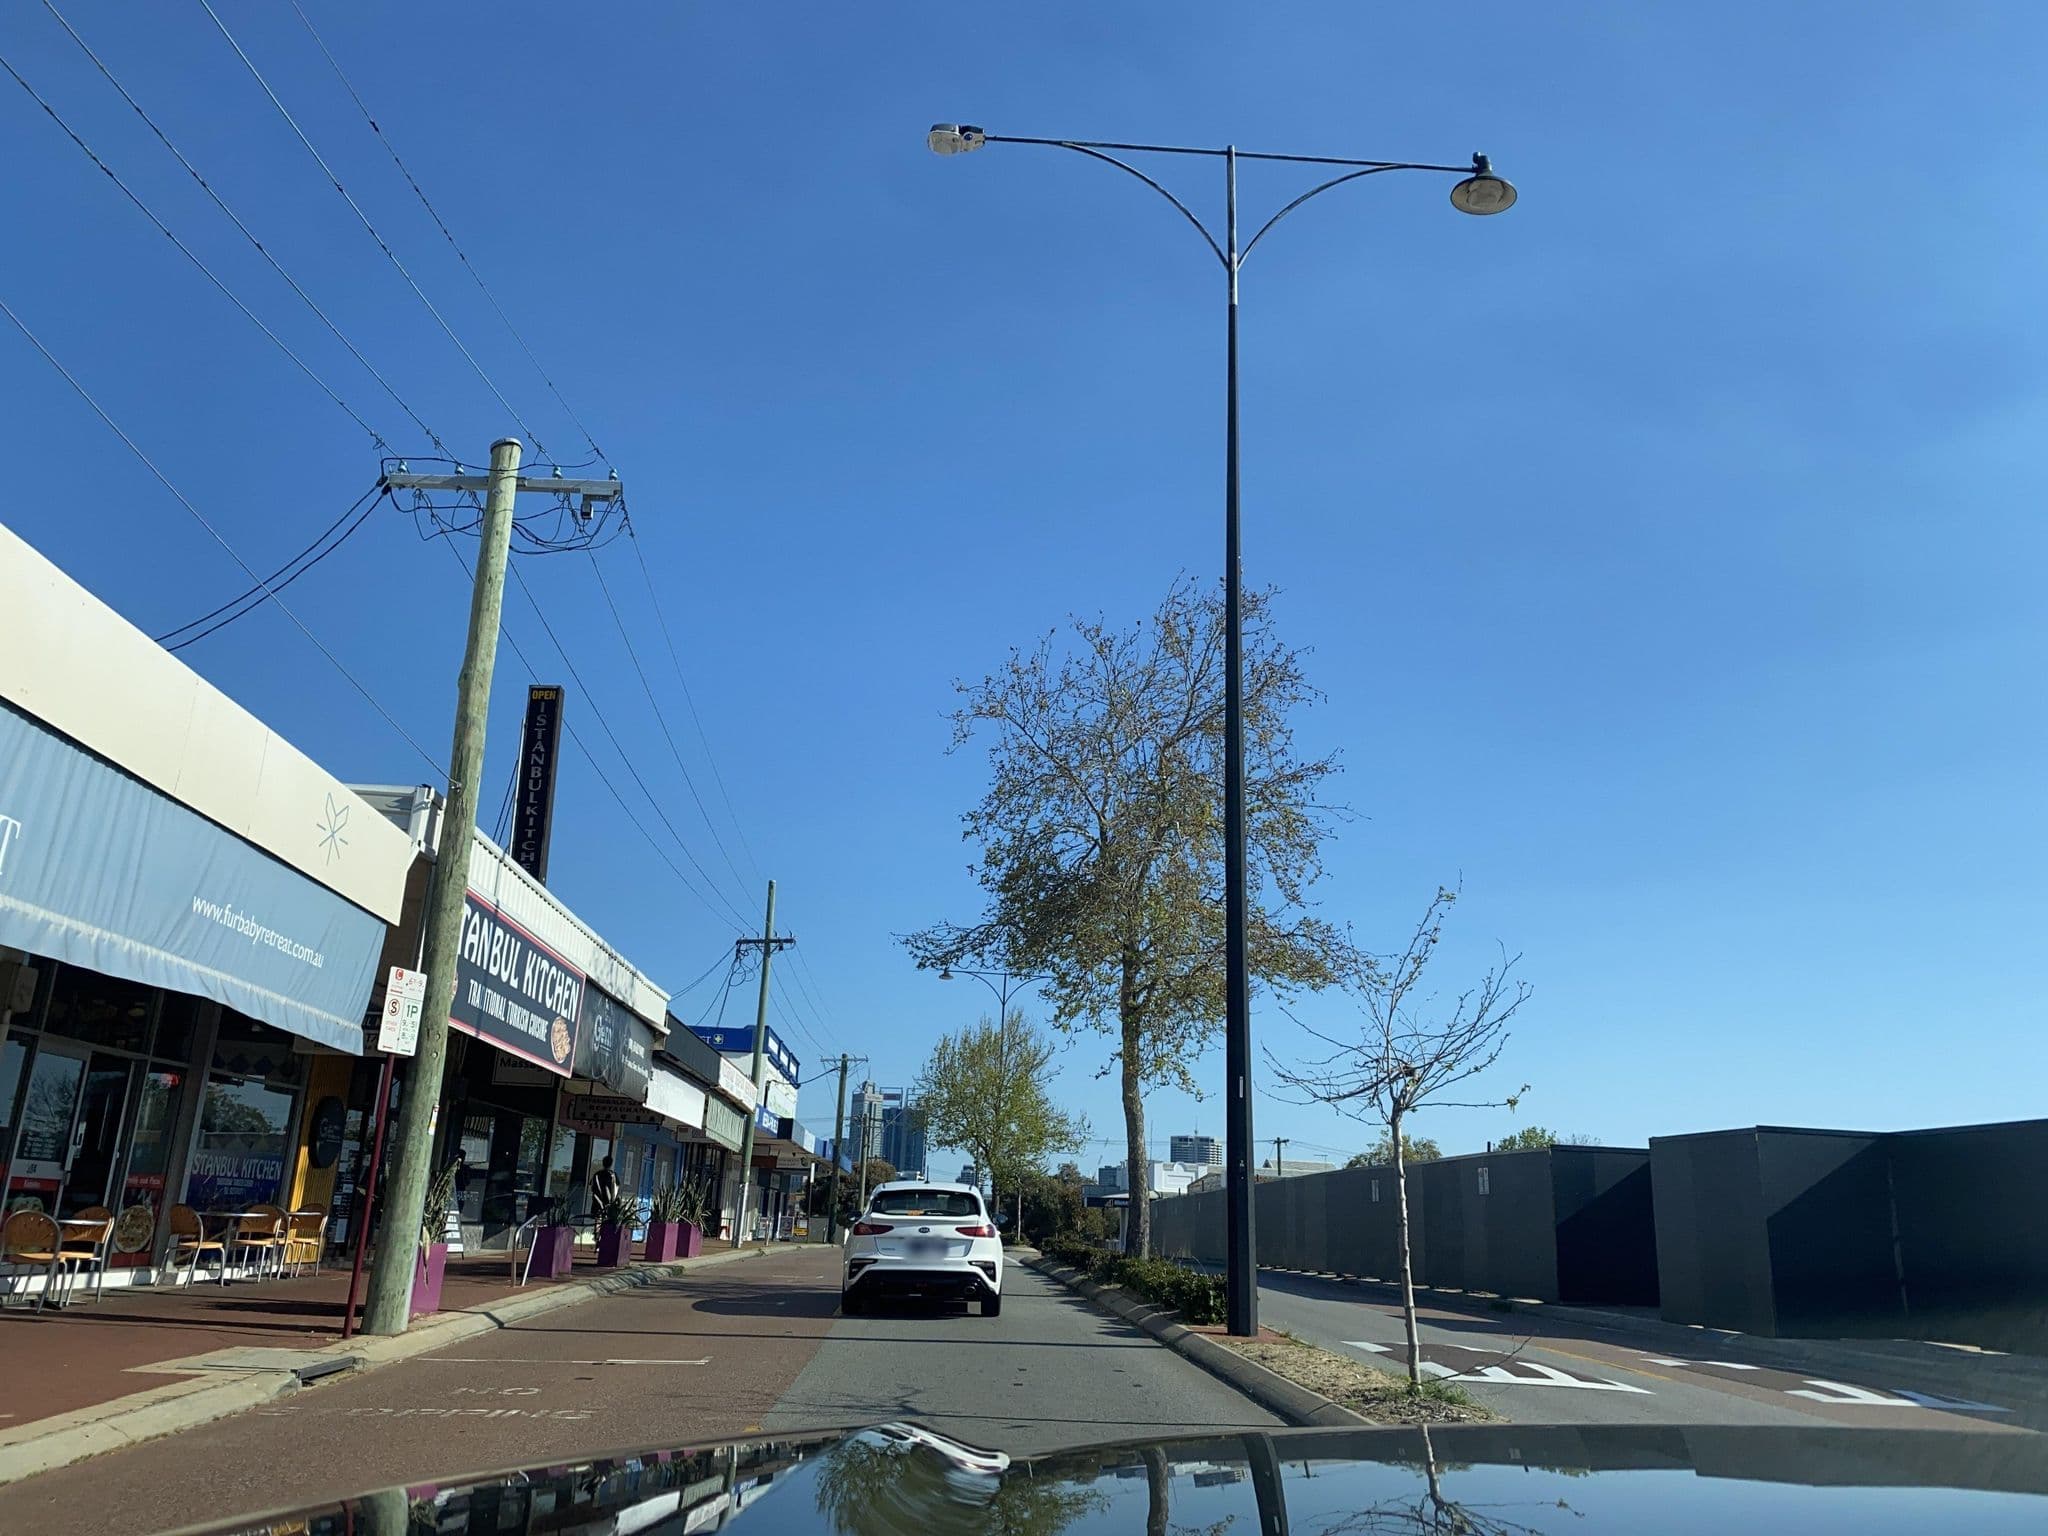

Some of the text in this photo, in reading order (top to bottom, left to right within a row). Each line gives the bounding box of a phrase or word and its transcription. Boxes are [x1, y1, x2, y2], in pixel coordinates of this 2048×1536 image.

[532, 690, 556, 701] OPEN
[522, 949, 581, 1024] KITCHEN
[406, 1004, 419, 1018] 1P
[467, 978, 549, 1043] TRADITIONAL TURKISH CUISINE
[240, 1158, 284, 1181] KITCHEN
[450, 1386, 543, 1396] NO
